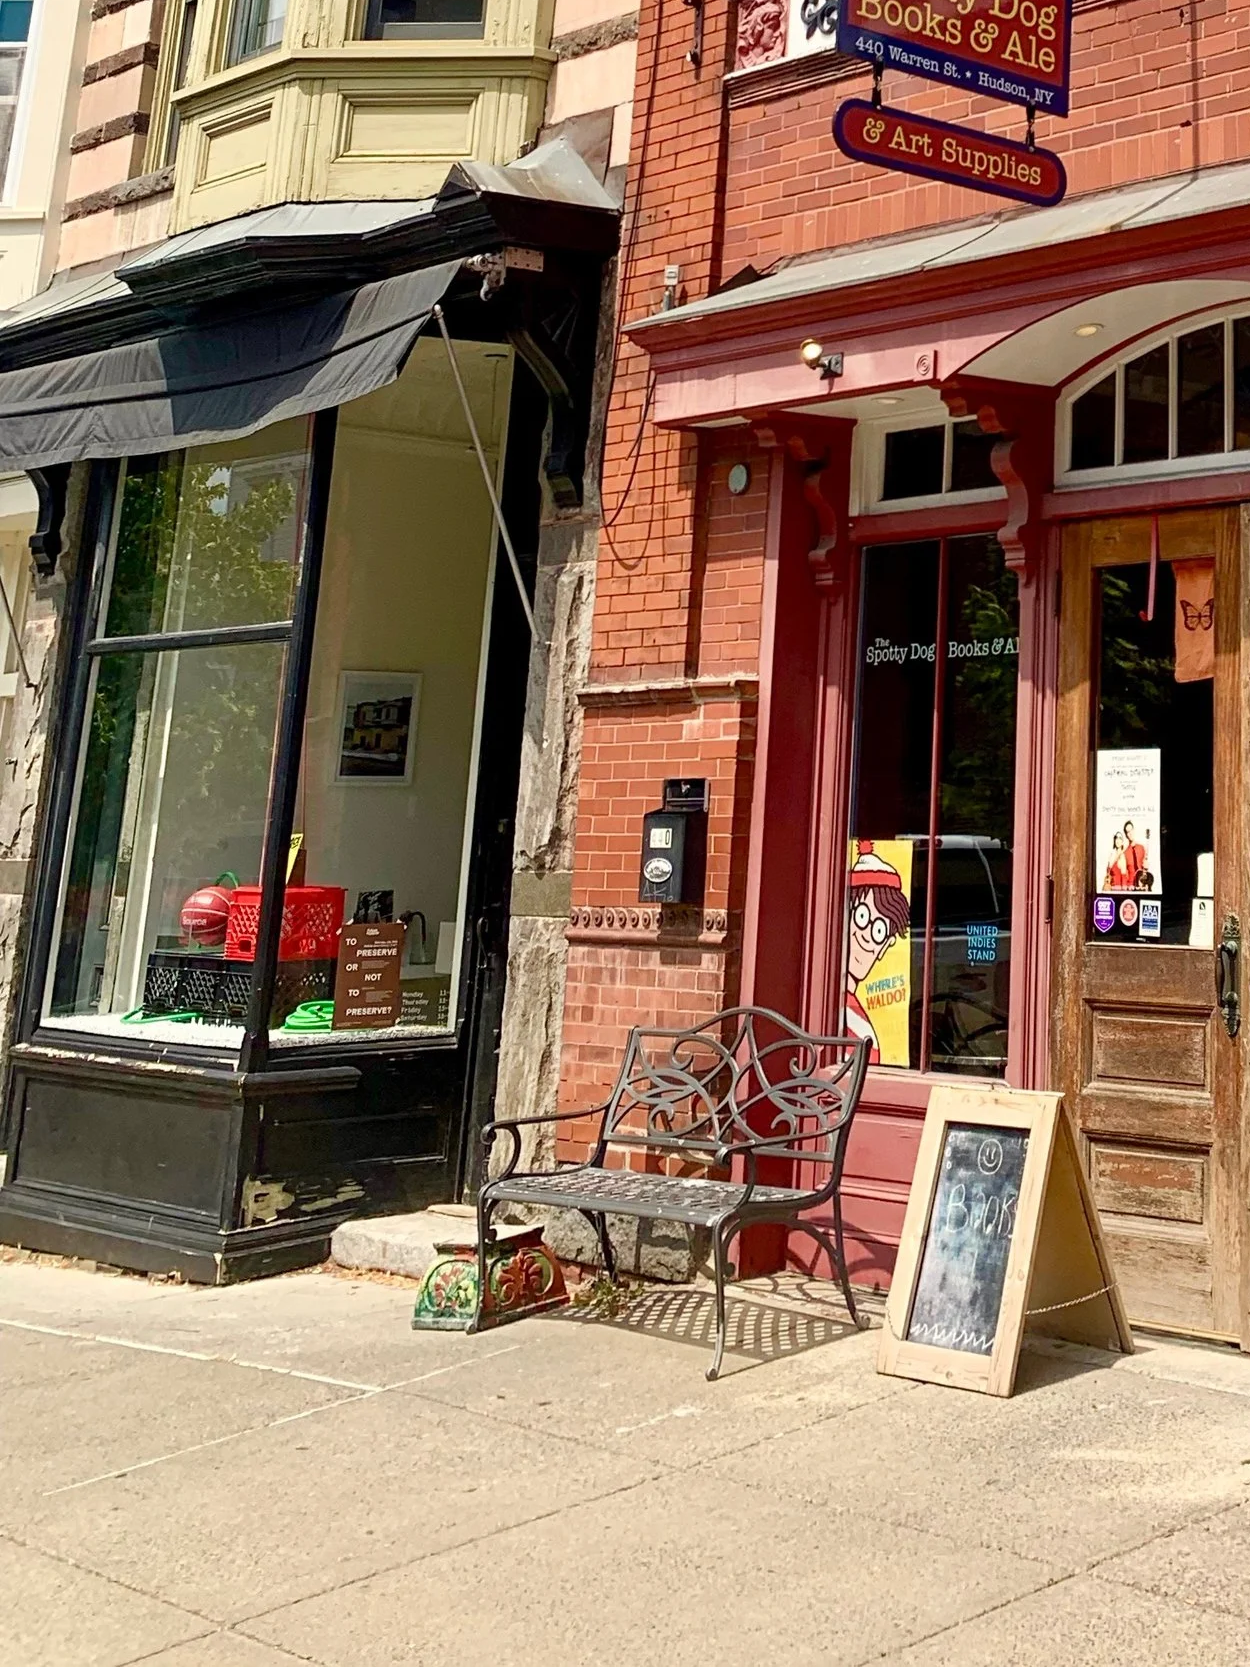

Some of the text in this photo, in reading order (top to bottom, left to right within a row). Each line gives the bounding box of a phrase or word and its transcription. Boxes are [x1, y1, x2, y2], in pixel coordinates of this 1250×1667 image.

[970, 19, 999, 54] &
[1001, 30, 1056, 73] Ale
[854, 36, 1055, 106] 440 Warren St. Hudson, NY
[862, 117, 1042, 186] & Art Supplies
[875, 637, 891, 648] The
[866, 636, 1020, 666] Spotty Dog Books & Al
[966, 924, 998, 937] UNITED
[346, 938, 357, 946] TO
[967, 937, 997, 949] INDIES
[357, 948, 397, 957] PRESERVE
[967, 949, 997, 961] STAND
[346, 964, 358, 972] OR
[364, 973, 382, 982] NOT
[865, 974, 906, 996] WHERE'S
[348, 989, 359, 997] TO
[866, 988, 907, 1011] WALDO?
[346, 1007, 392, 1016] PRESERVE?
